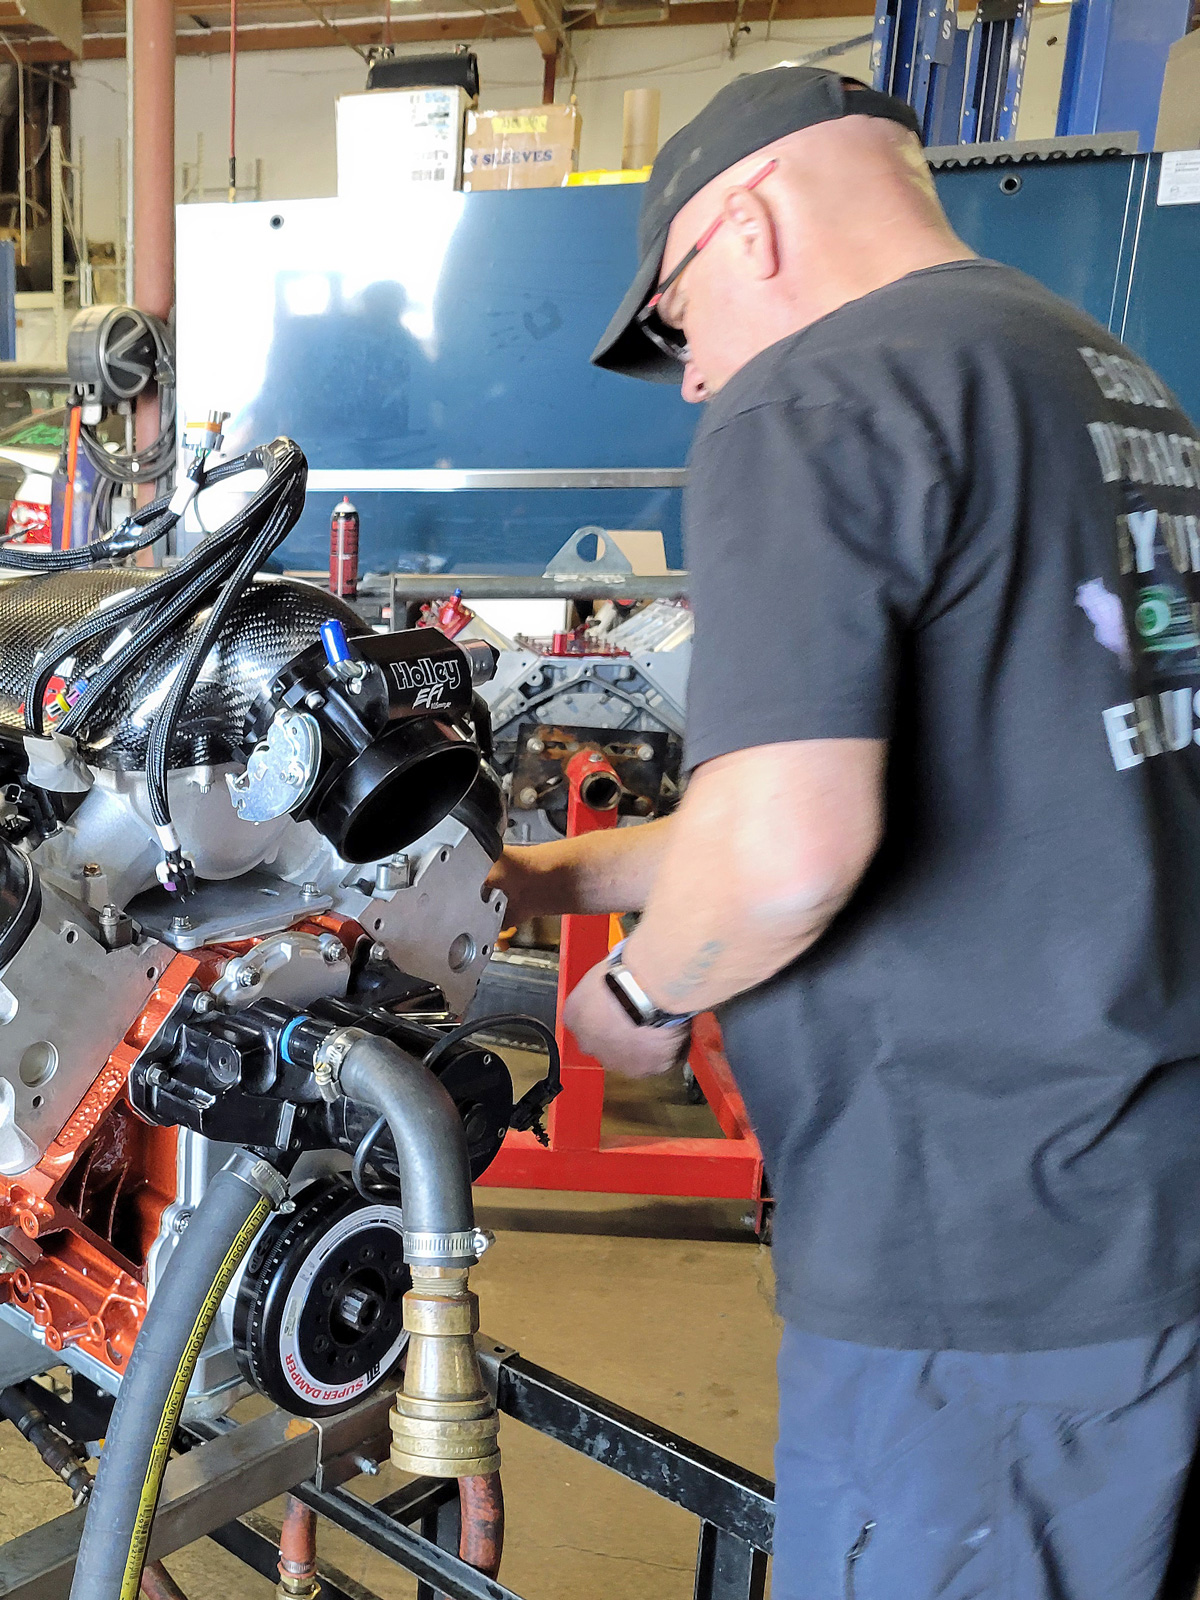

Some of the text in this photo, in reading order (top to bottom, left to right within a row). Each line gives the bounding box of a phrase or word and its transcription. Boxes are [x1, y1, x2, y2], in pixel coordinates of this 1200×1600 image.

[482, 149, 552, 165] SLEEVES
[390, 658, 461, 690] Holley
[199, 1267, 232, 1328] FLEETFLEX
[186, 1331, 204, 1363] GOLD
[285, 1353, 322, 1399] DAMPER
[322, 1377, 364, 1400] SUPER
[159, 1417, 174, 1445] INCH
